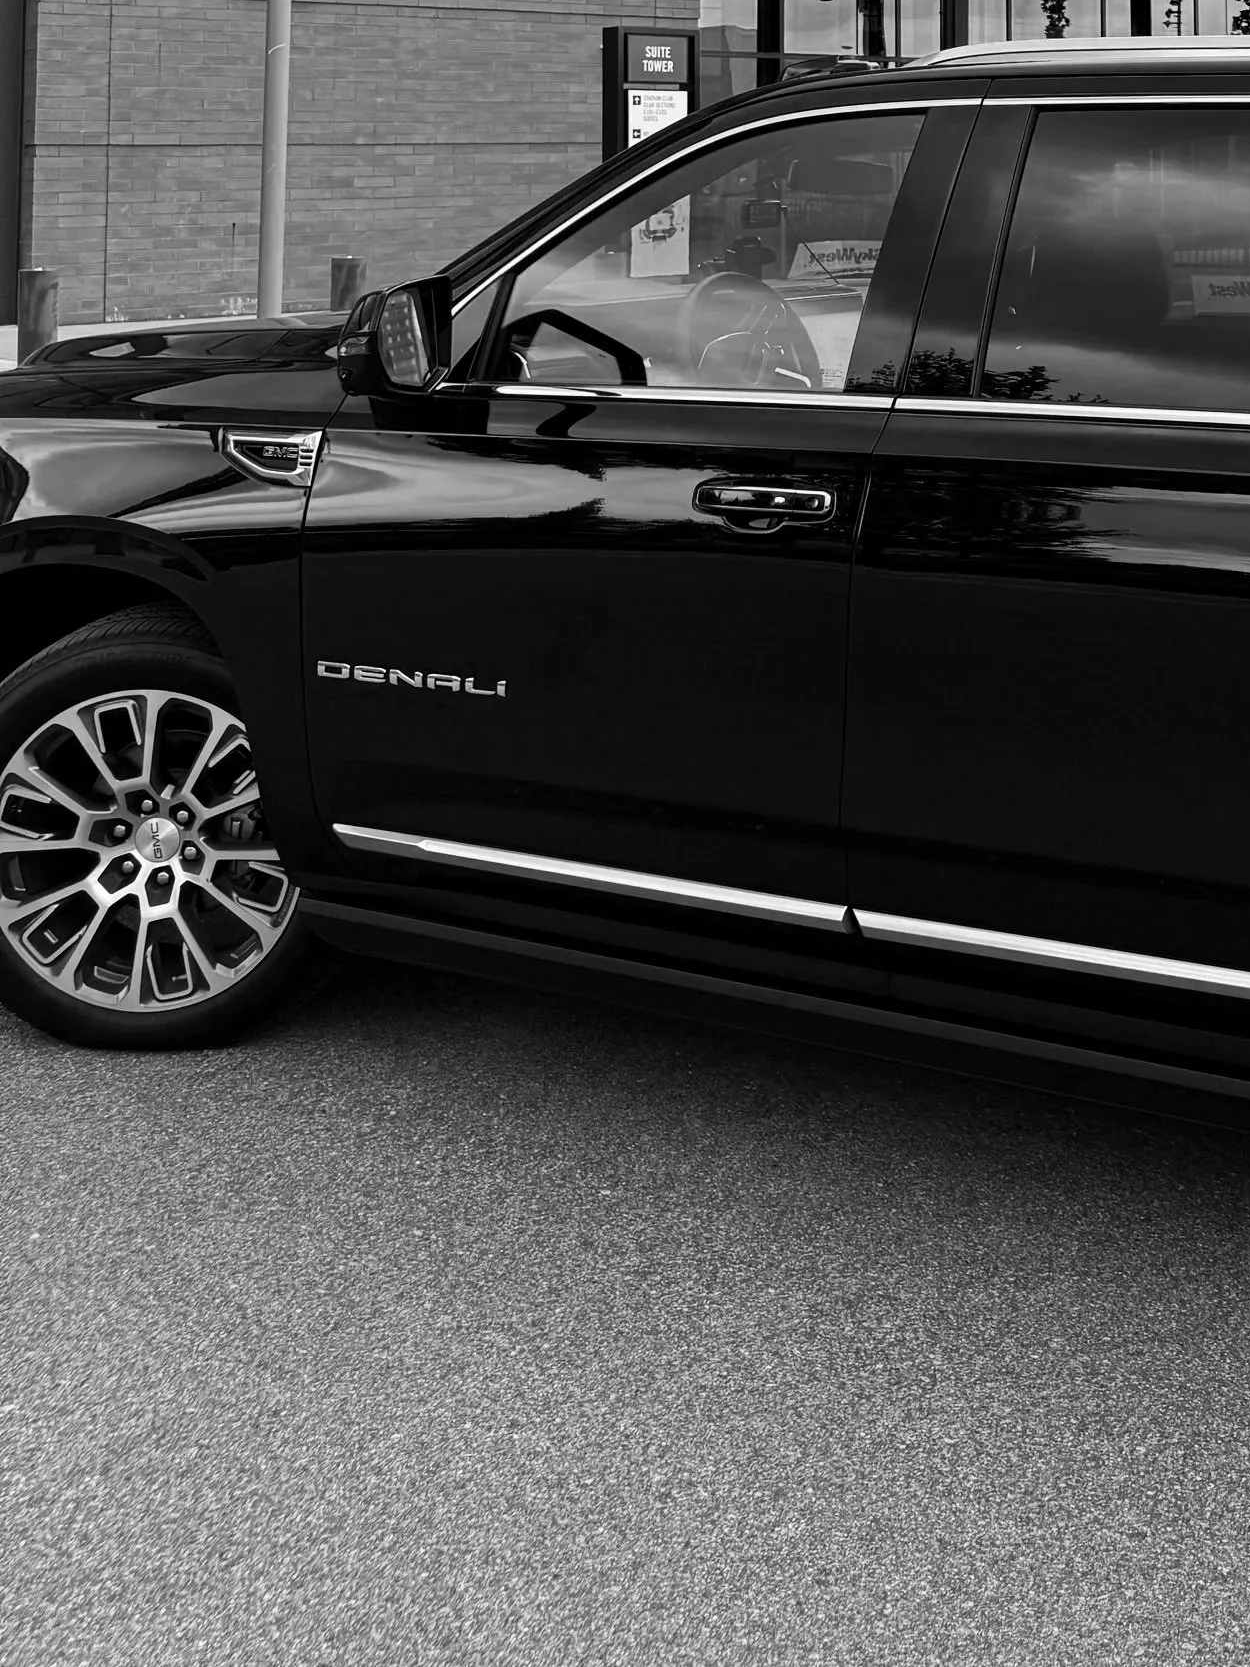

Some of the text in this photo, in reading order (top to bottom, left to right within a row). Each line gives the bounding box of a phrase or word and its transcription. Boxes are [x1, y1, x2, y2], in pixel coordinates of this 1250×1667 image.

[645, 45, 671, 59] SUITE
[642, 58, 674, 73] TOWER
[262, 446, 298, 459] GMC
[317, 660, 507, 697] DENALI
[150, 821, 163, 859] GMC
